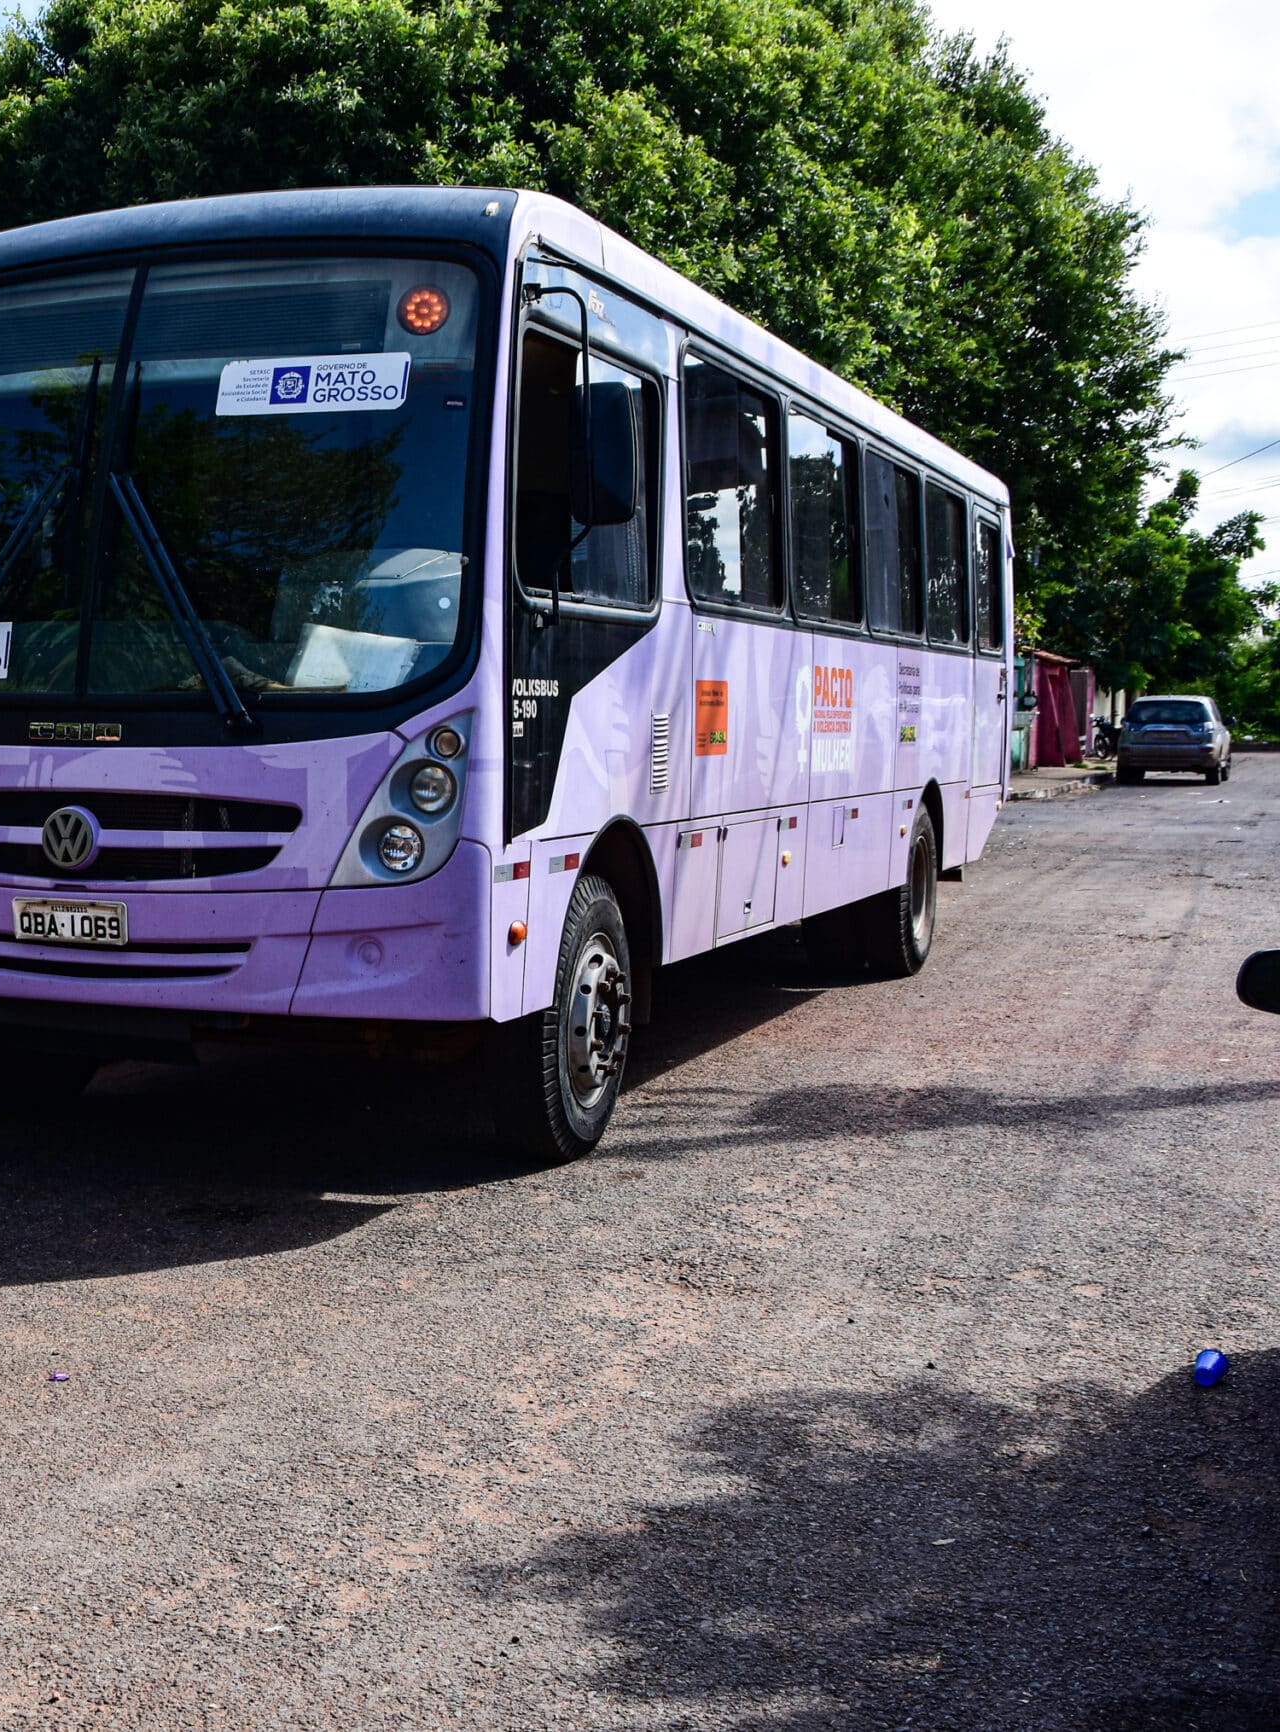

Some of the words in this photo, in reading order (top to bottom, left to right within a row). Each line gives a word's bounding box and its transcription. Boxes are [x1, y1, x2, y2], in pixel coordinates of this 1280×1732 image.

[317, 363, 356, 371] GOVERNO
[315, 370, 376, 387] MATO
[313, 385, 399, 403] GROSSO
[814, 665, 853, 708] PACTO
[28, 721, 122, 741] CAIO
[813, 738, 851, 771] MULHER
